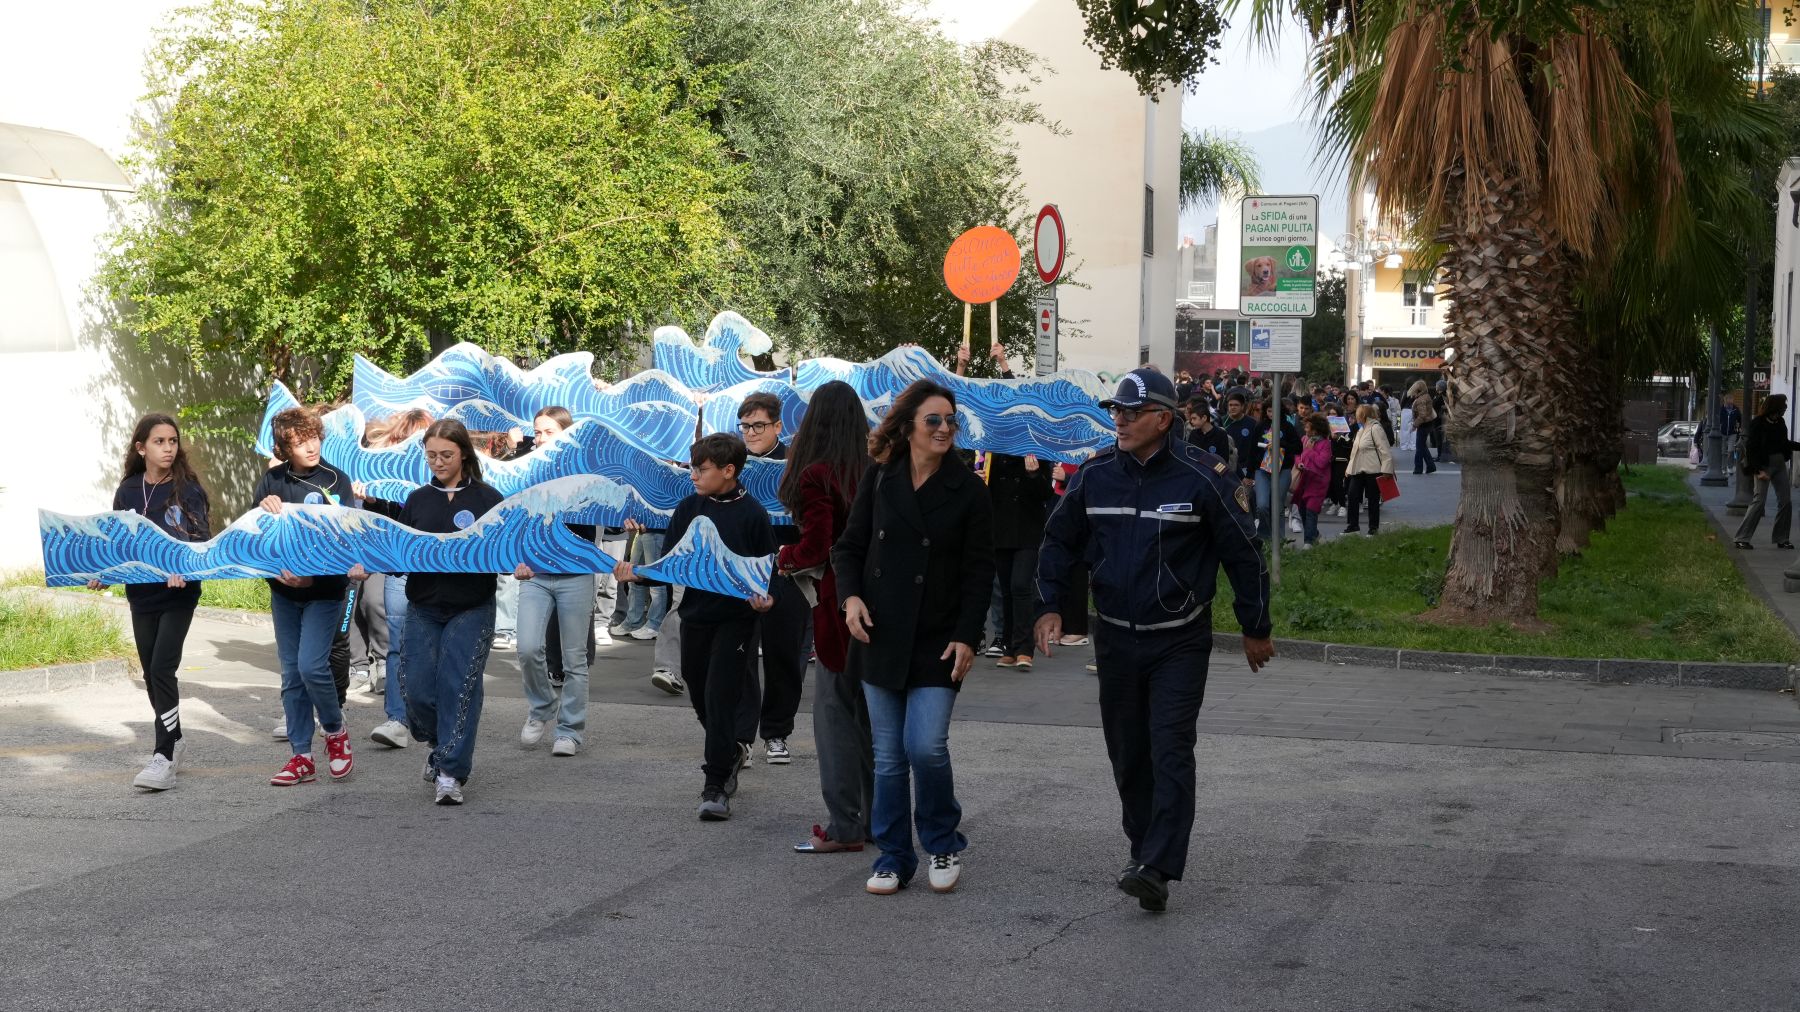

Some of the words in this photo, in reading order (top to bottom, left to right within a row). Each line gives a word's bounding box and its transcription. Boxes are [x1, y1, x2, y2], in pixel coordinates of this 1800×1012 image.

[1260, 211, 1287, 220] SFIDA
[1245, 223, 1279, 233] PAGANI
[1281, 223, 1313, 232] PULITA
[1273, 235, 1287, 243] ogni
[1288, 235, 1308, 243] giorno.
[1247, 302, 1307, 313] RACCOGLILA
[341, 589, 355, 632] GIVOVA
